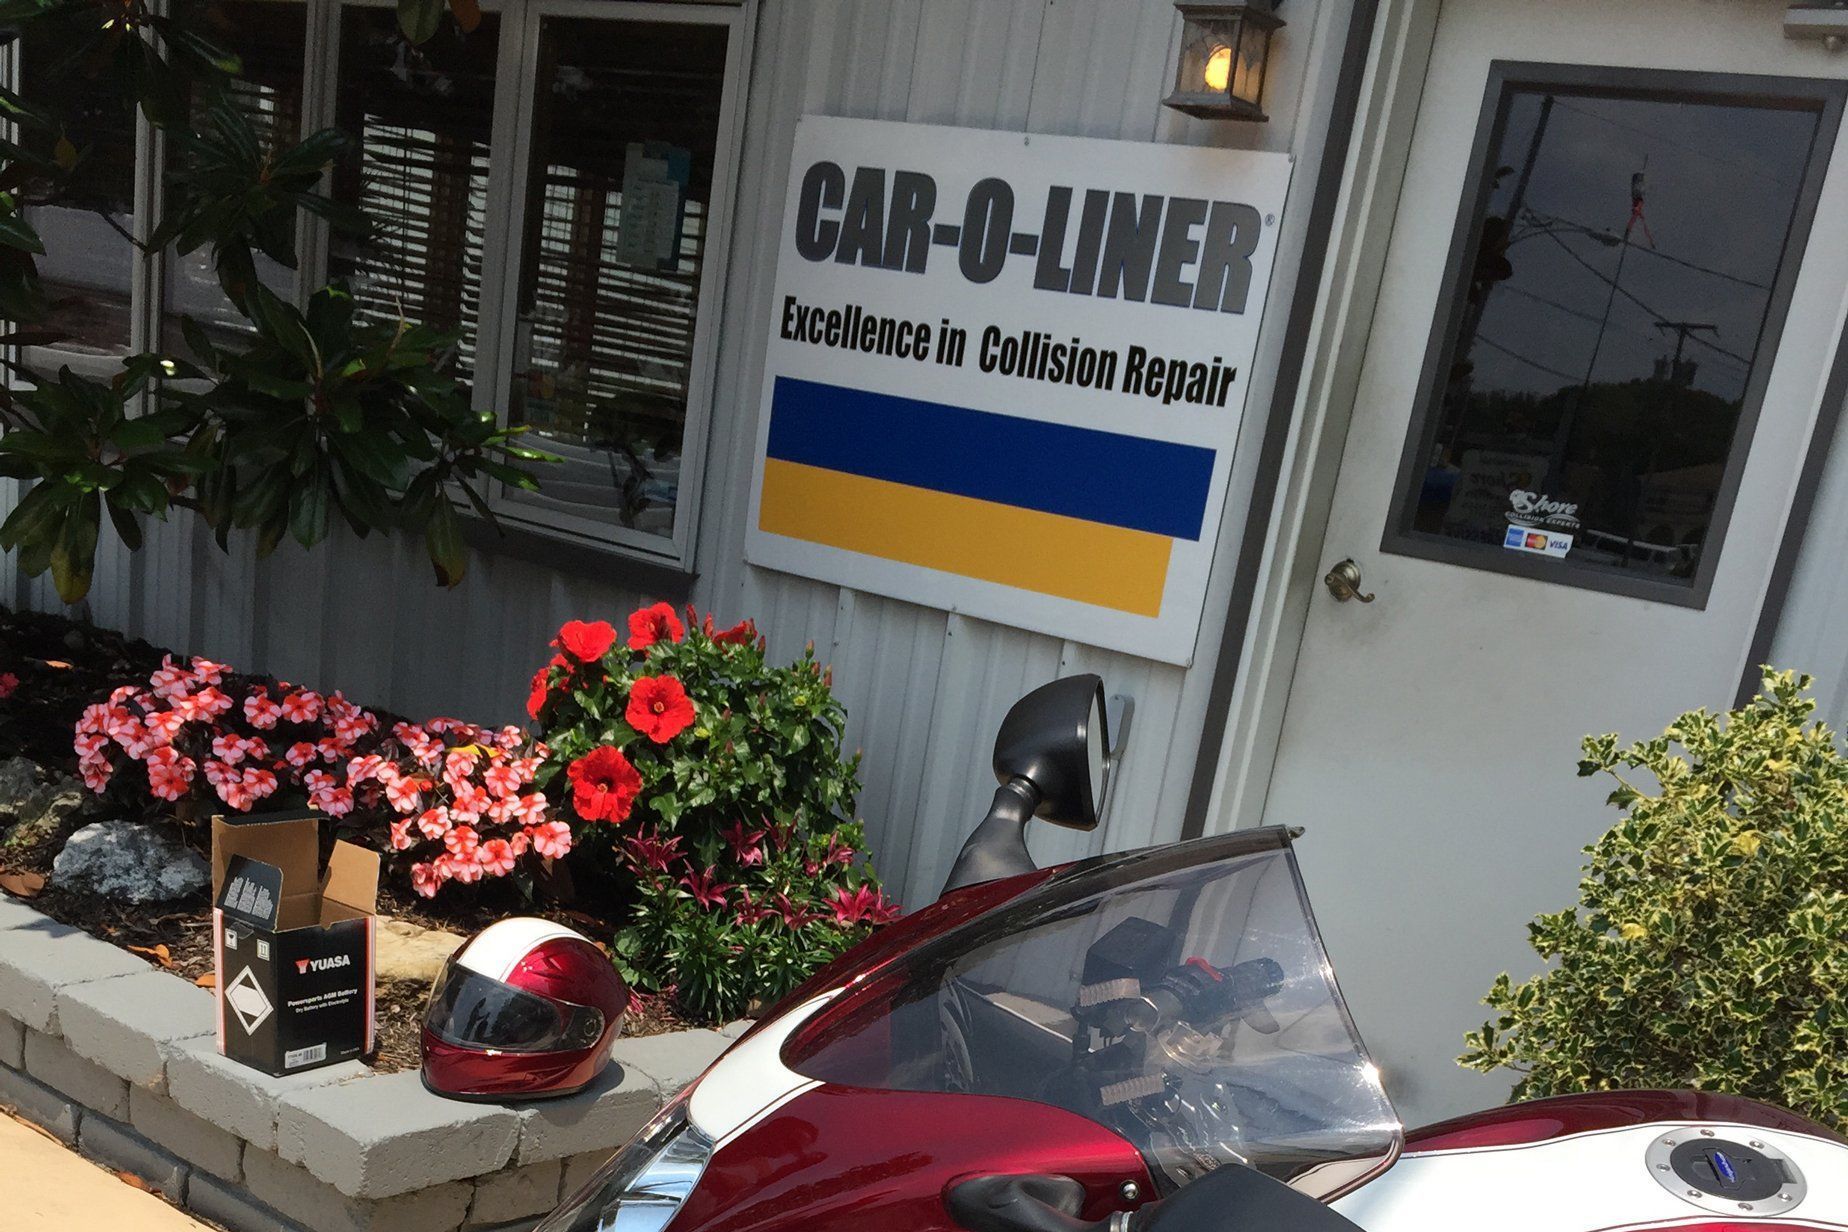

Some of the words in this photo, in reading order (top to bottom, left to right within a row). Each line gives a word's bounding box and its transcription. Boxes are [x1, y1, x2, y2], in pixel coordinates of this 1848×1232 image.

[780, 296, 931, 362] Excellence
[935, 318, 967, 368] in
[978, 325, 1119, 391] Collision
[1122, 345, 1237, 408] Repair
[1549, 540, 1568, 550] VISA
[310, 955, 350, 972] YUASA
